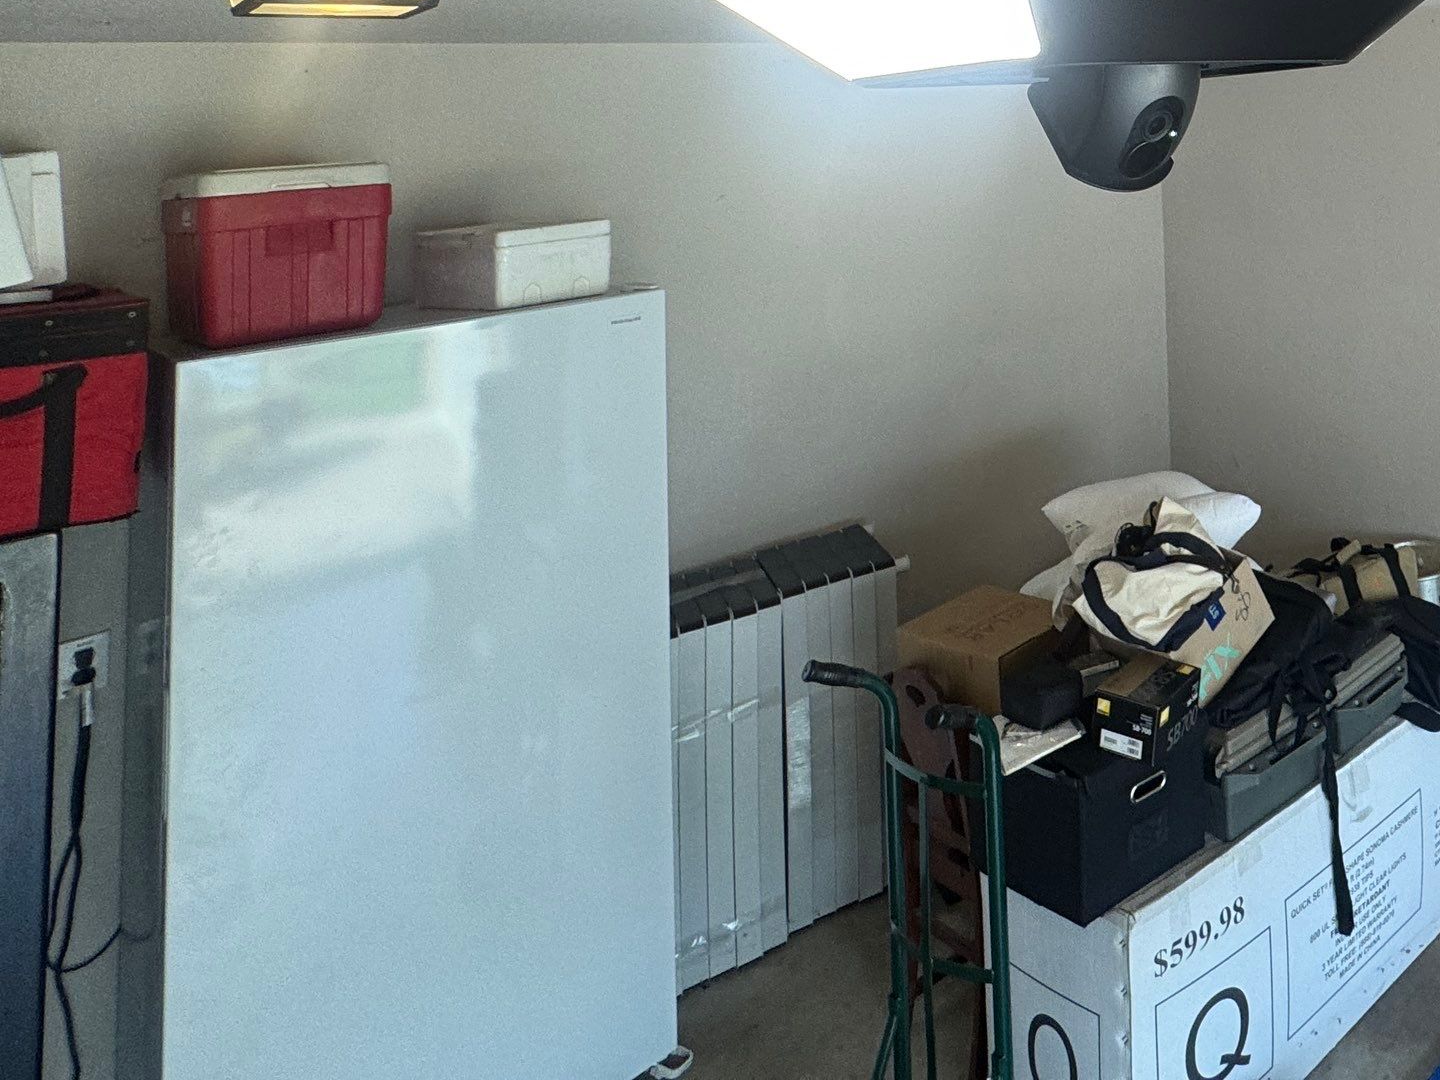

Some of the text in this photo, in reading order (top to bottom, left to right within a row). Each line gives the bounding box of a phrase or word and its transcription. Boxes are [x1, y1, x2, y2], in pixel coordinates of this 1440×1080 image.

[1290, 896, 1311, 918] QUICK
[1365, 831, 1389, 856] SONOMA
[1390, 805, 1418, 835] CASHMERE
[1354, 879, 1390, 918] RETARDANT
[1368, 871, 1387, 892] CLEAR
[1388, 852, 1407, 874] LIGHTS
[1154, 896, 1245, 978] $599.98
[1327, 946, 1343, 966] YEAR
[1367, 895, 1397, 929] WARRANTY
[1185, 987, 1251, 1080] Q
